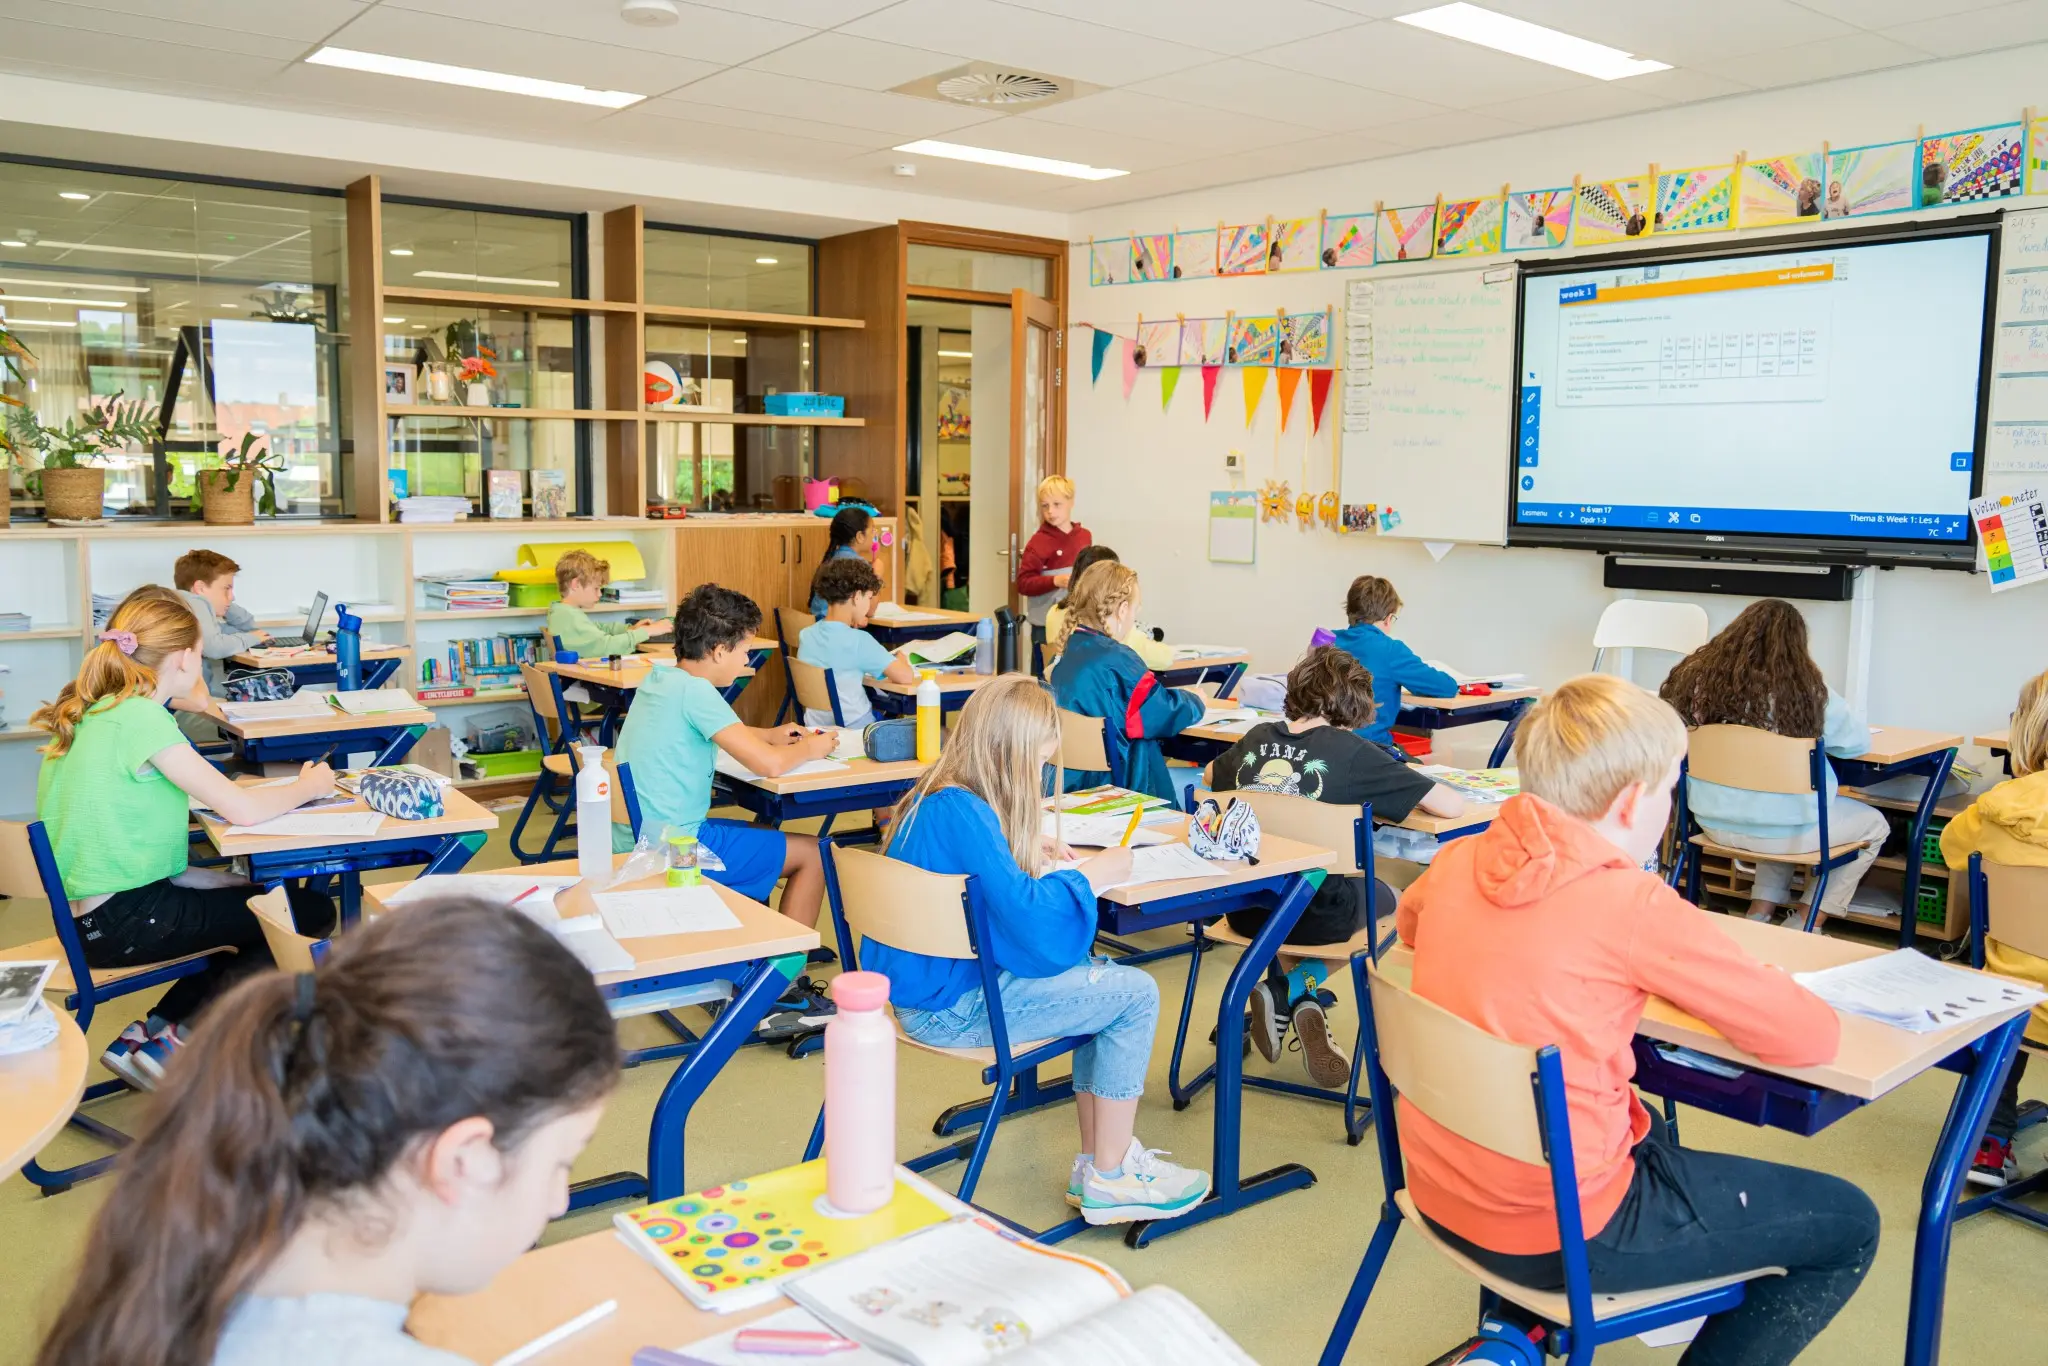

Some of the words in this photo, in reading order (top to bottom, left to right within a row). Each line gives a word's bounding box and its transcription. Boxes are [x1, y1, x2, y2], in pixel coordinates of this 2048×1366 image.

[1561, 288, 1585, 299] week
[1522, 509, 1547, 517] Lesmenu
[1580, 516, 1596, 524] Opdr
[1850, 514, 1875, 523] Thema
[1877, 515, 1884, 523] 8:
[1886, 515, 1908, 523] Week
[1911, 516, 1917, 524] 1:
[1919, 516, 1932, 524] Les
[1260, 743, 1308, 761] VANS
